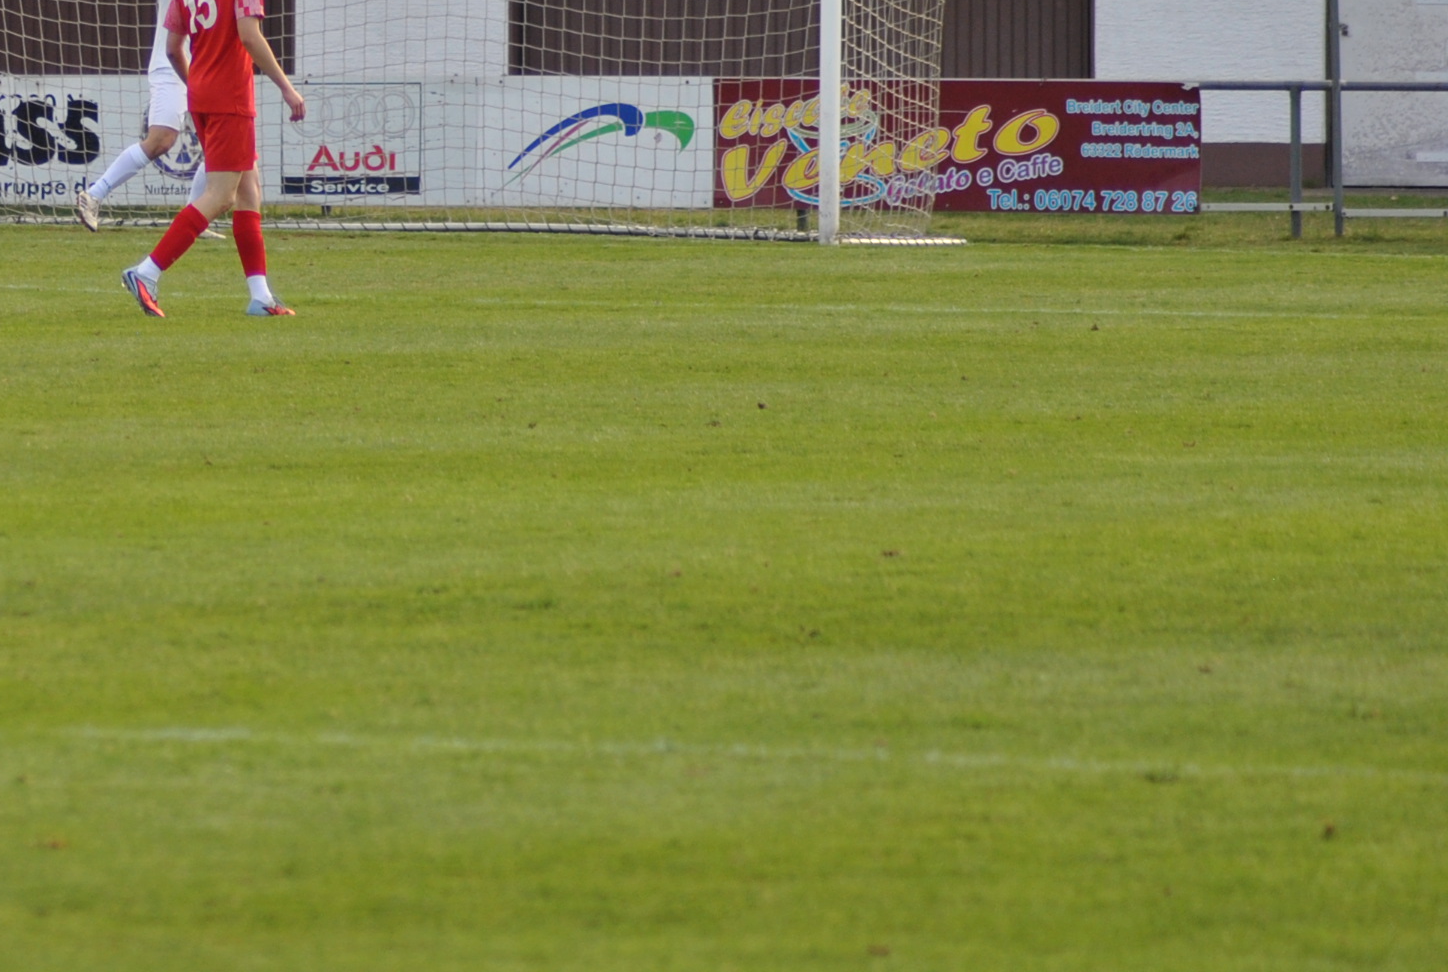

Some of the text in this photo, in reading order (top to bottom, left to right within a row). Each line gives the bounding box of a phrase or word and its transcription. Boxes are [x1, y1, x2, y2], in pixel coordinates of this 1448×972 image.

[1066, 98, 1200, 117] Breidert City Center
[1091, 121, 1200, 139] Breidertring 2A,
[306, 144, 396, 171] Audi
[1123, 142, 1200, 159] Rödermark
[977, 167, 994, 186] e
[998, 153, 1063, 183] Caffe
[310, 179, 390, 193] Service
[987, 189, 1198, 212] Tel.: 06074 728 87 26
